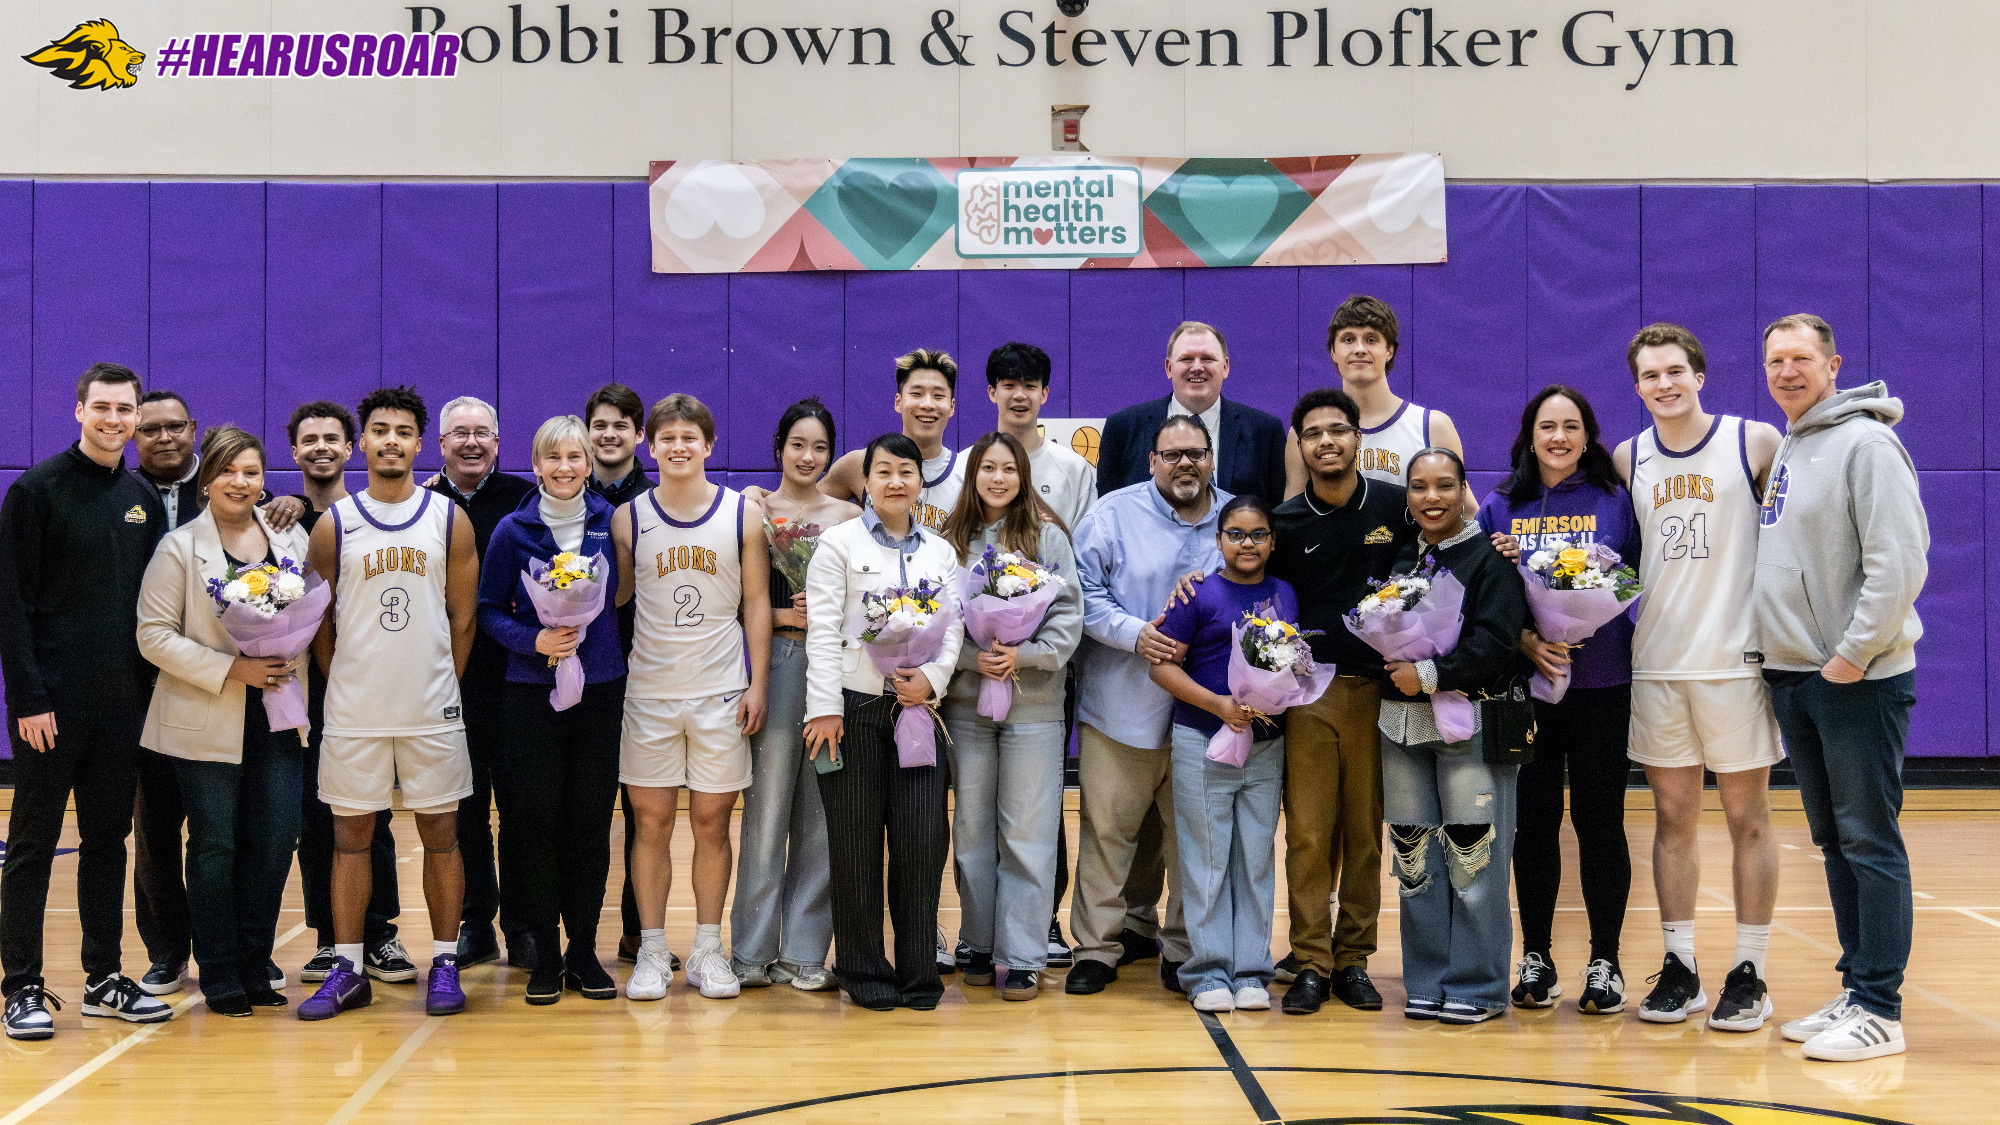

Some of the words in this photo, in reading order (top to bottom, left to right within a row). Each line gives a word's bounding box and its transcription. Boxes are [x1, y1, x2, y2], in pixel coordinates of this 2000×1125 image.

[647, 7, 896, 65] Brown
[919, 9, 976, 67] &
[996, 9, 1243, 67] Steven
[1266, 7, 1538, 67] Plofker
[1561, 9, 1738, 91] Gym
[1003, 174, 1114, 198] mental
[1003, 198, 1104, 223] health
[1653, 473, 1714, 510] LIONS
[1510, 514, 1597, 534] EMERSON
[1660, 512, 1709, 562] 21
[363, 546, 427, 581] LIONS
[655, 545, 717, 579] LIONS
[379, 586, 411, 632] 3
[673, 584, 705, 627] 2
